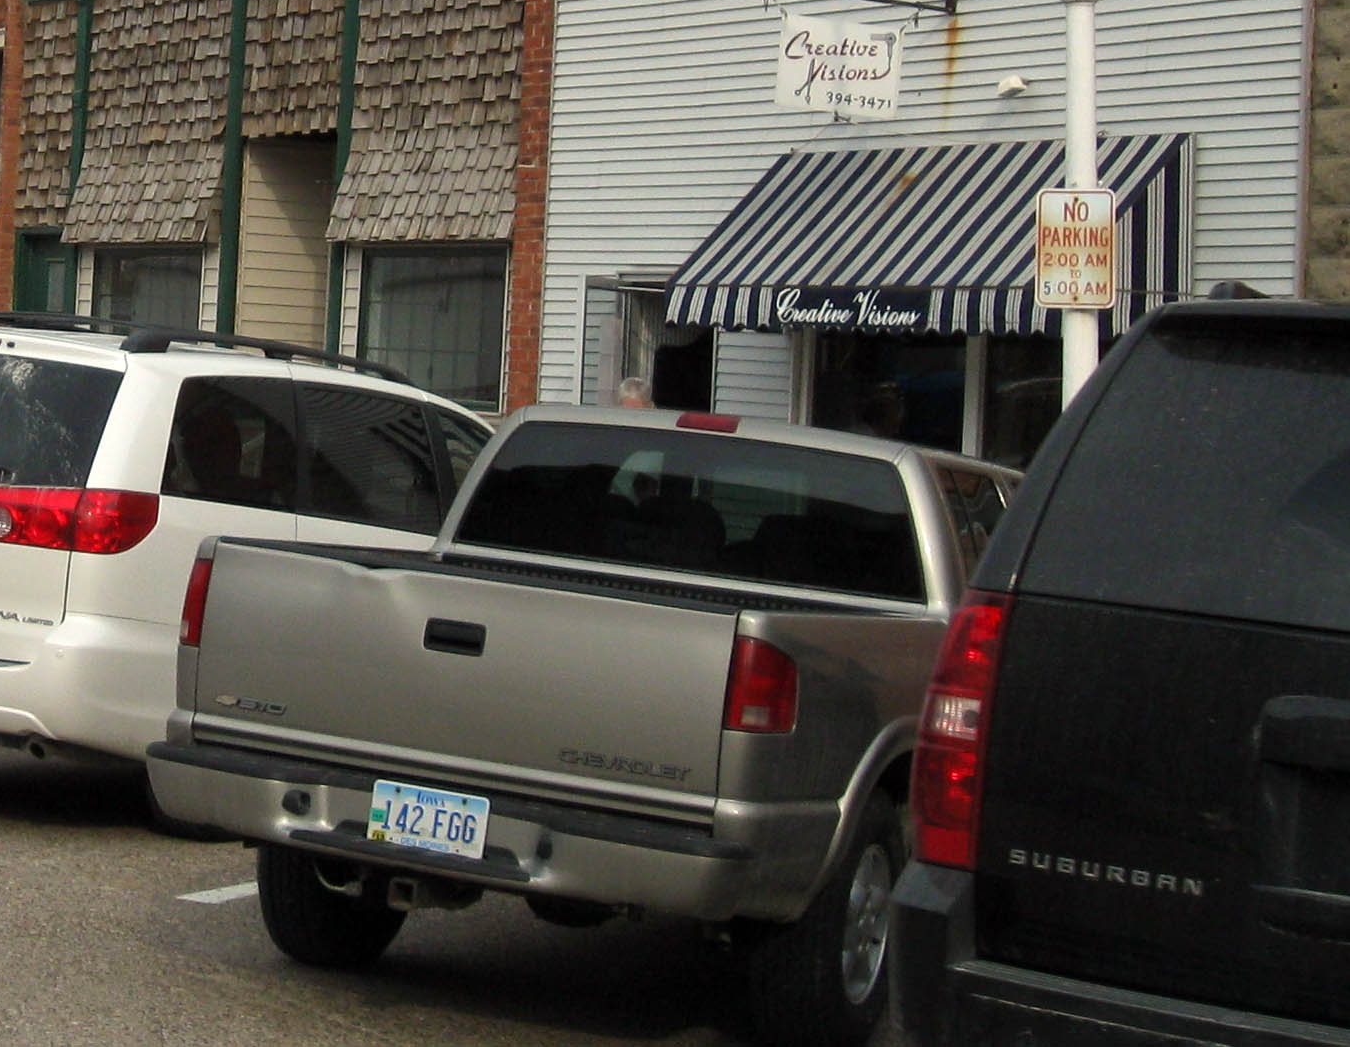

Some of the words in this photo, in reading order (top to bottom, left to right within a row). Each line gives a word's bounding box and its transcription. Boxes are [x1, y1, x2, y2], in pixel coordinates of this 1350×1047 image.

[785, 30, 878, 59] Creative
[807, 58, 879, 81] Visions
[826, 91, 891, 110] 394-3471
[1063, 201, 1089, 222] NO
[1041, 226, 1110, 247] PARKING
[1085, 254, 1107, 268] AM
[1070, 269, 1082, 279] TO
[1083, 281, 1107, 295] AM
[776, 288, 853, 323] Creative
[853, 288, 921, 326] Visions
[559, 748, 692, 781] CHEVROLET
[381, 799, 425, 836] 142
[432, 808, 478, 844] FGG
[1008, 848, 1204, 896] SUBURBAN
